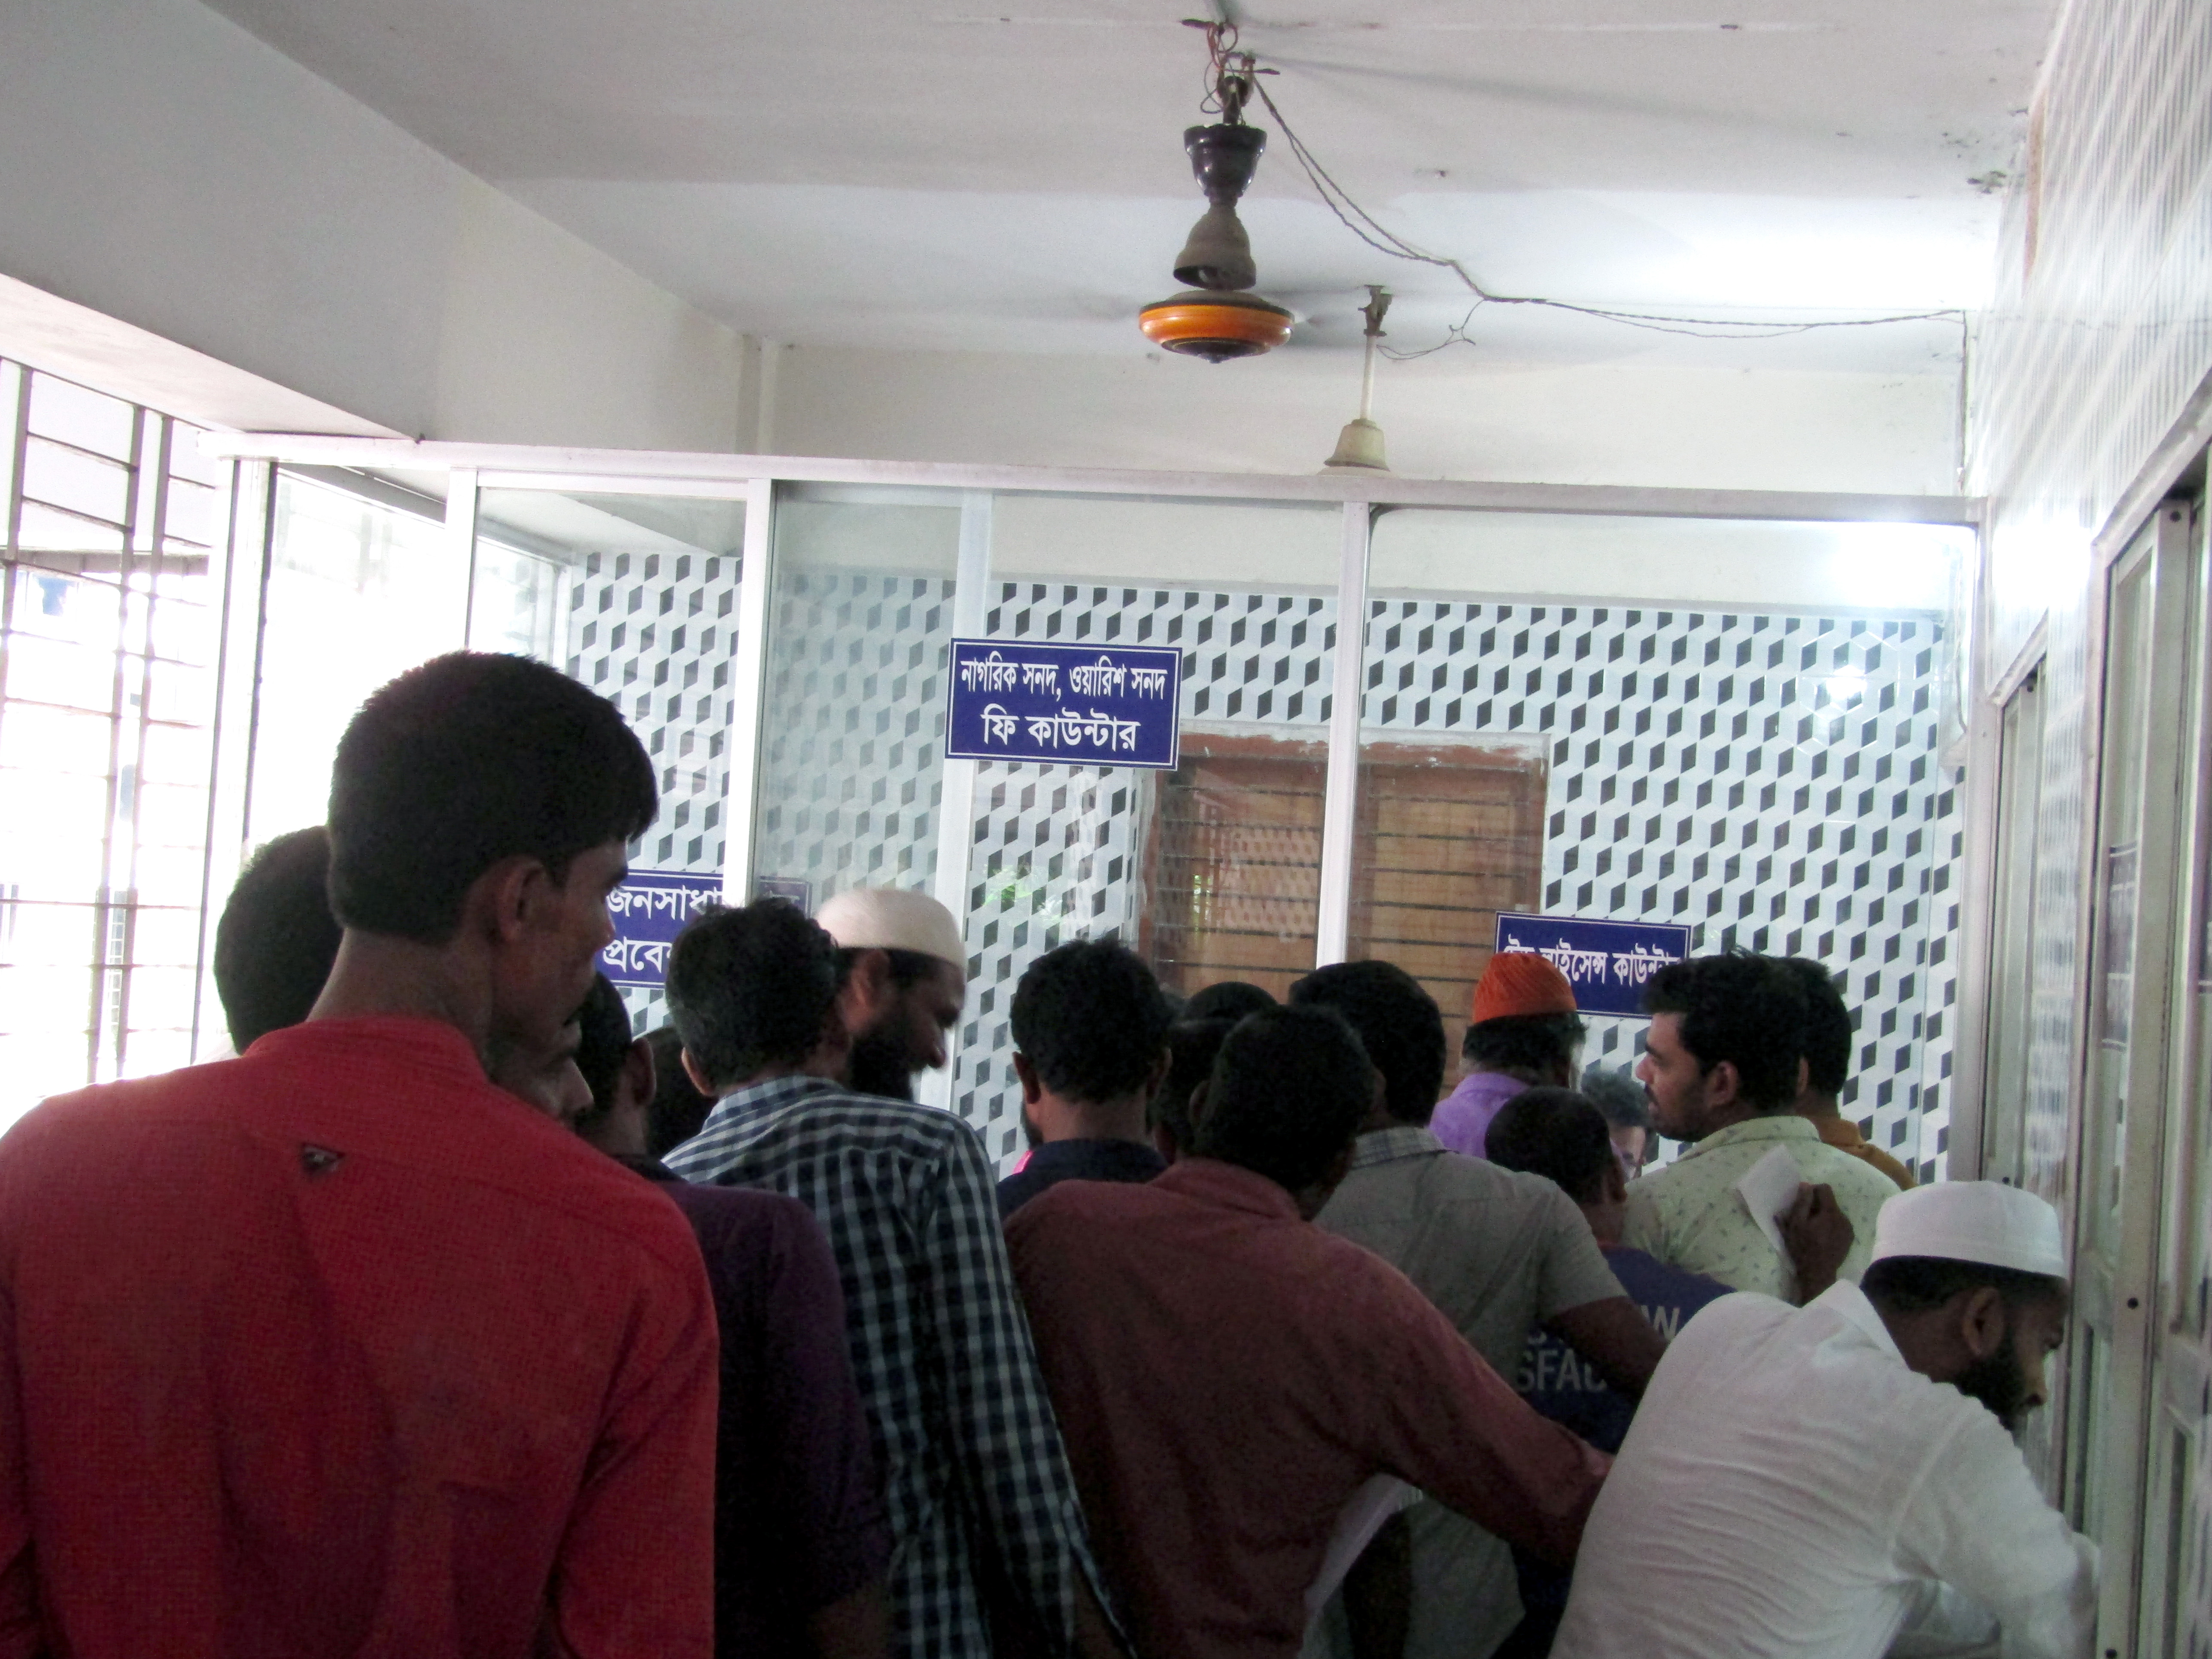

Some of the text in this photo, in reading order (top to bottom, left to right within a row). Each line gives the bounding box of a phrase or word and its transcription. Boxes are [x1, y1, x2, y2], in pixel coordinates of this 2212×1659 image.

[960, 650, 1168, 702] নাগরিক সনদ, ওয়ারিশ সনদ
[980, 702, 1142, 752] ফি কাউন্টার
[603, 936, 672, 973] প্রবে
